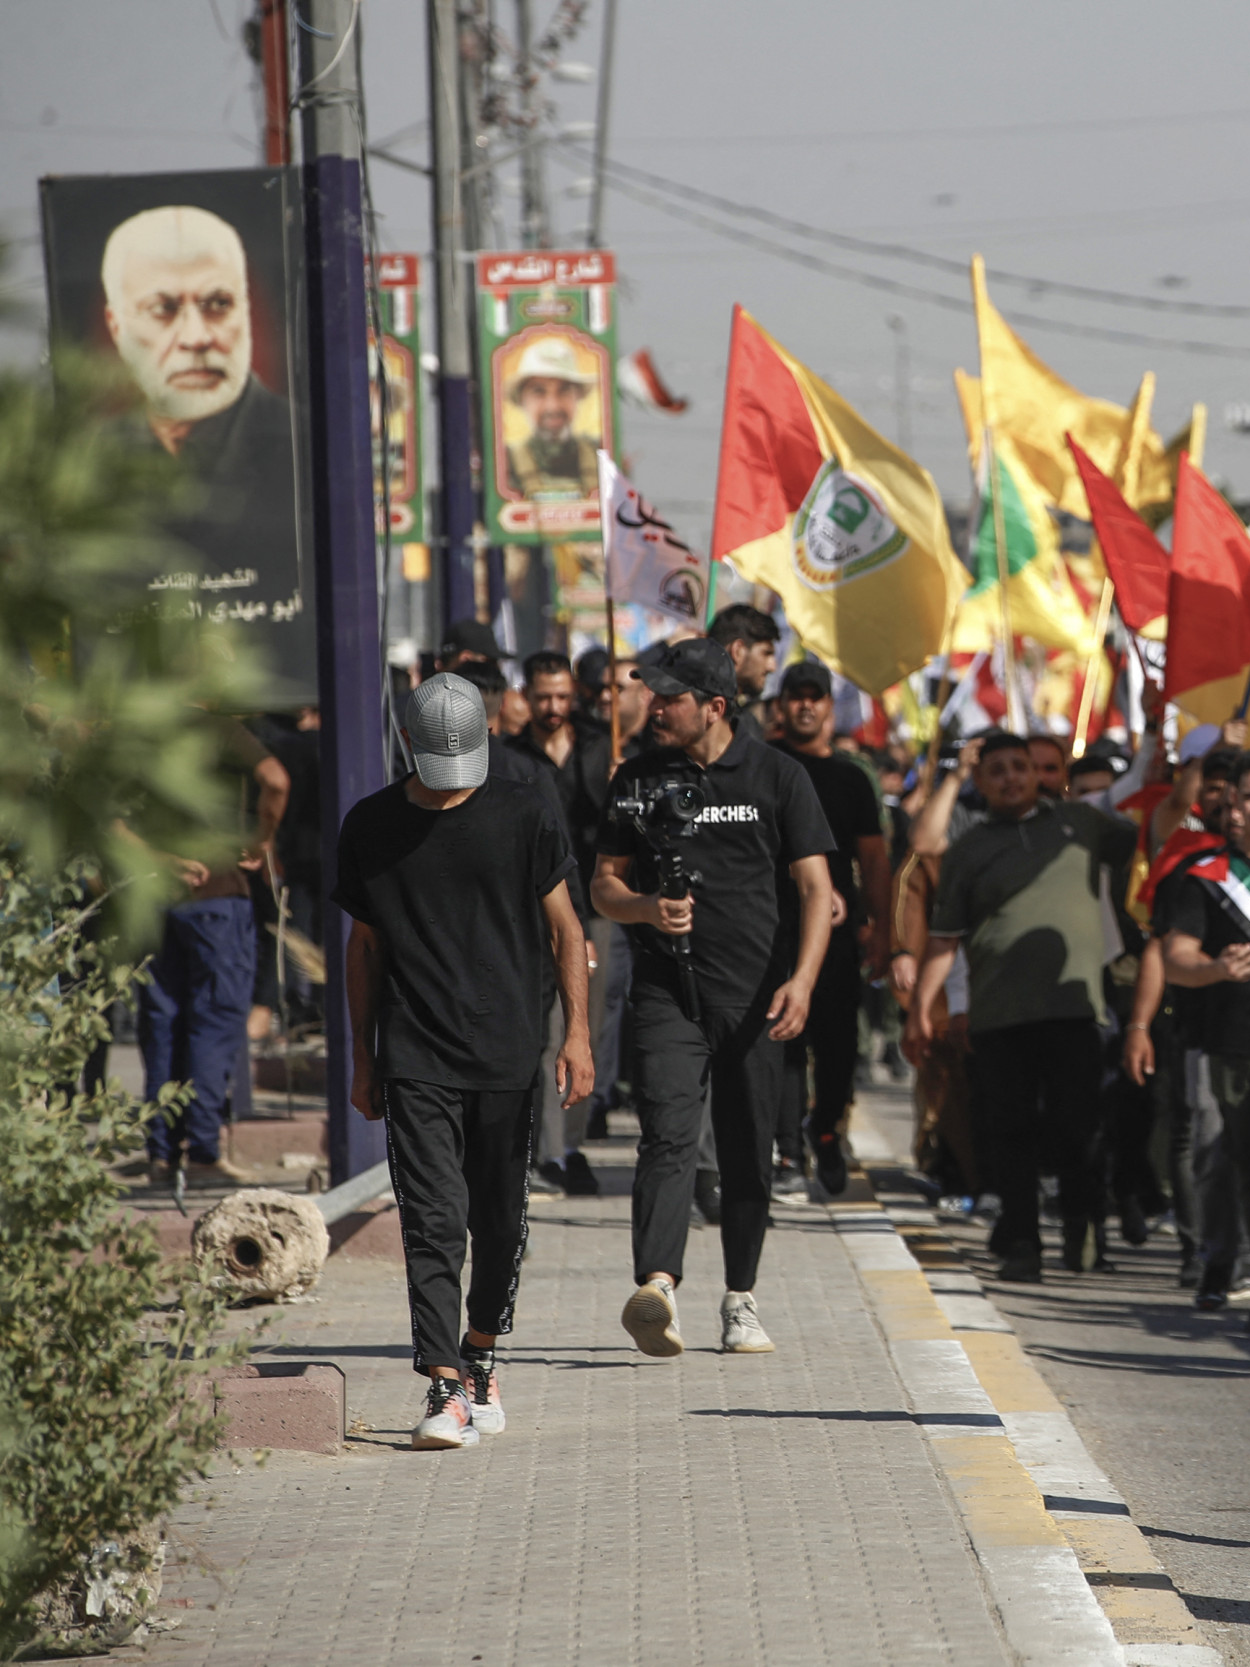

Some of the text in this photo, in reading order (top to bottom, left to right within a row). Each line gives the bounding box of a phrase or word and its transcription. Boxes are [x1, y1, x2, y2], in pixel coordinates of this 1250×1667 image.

[487, 254, 604, 284] شارع القدس
[200, 568, 258, 593] الشهيد
[208, 601, 268, 624] مهدي
